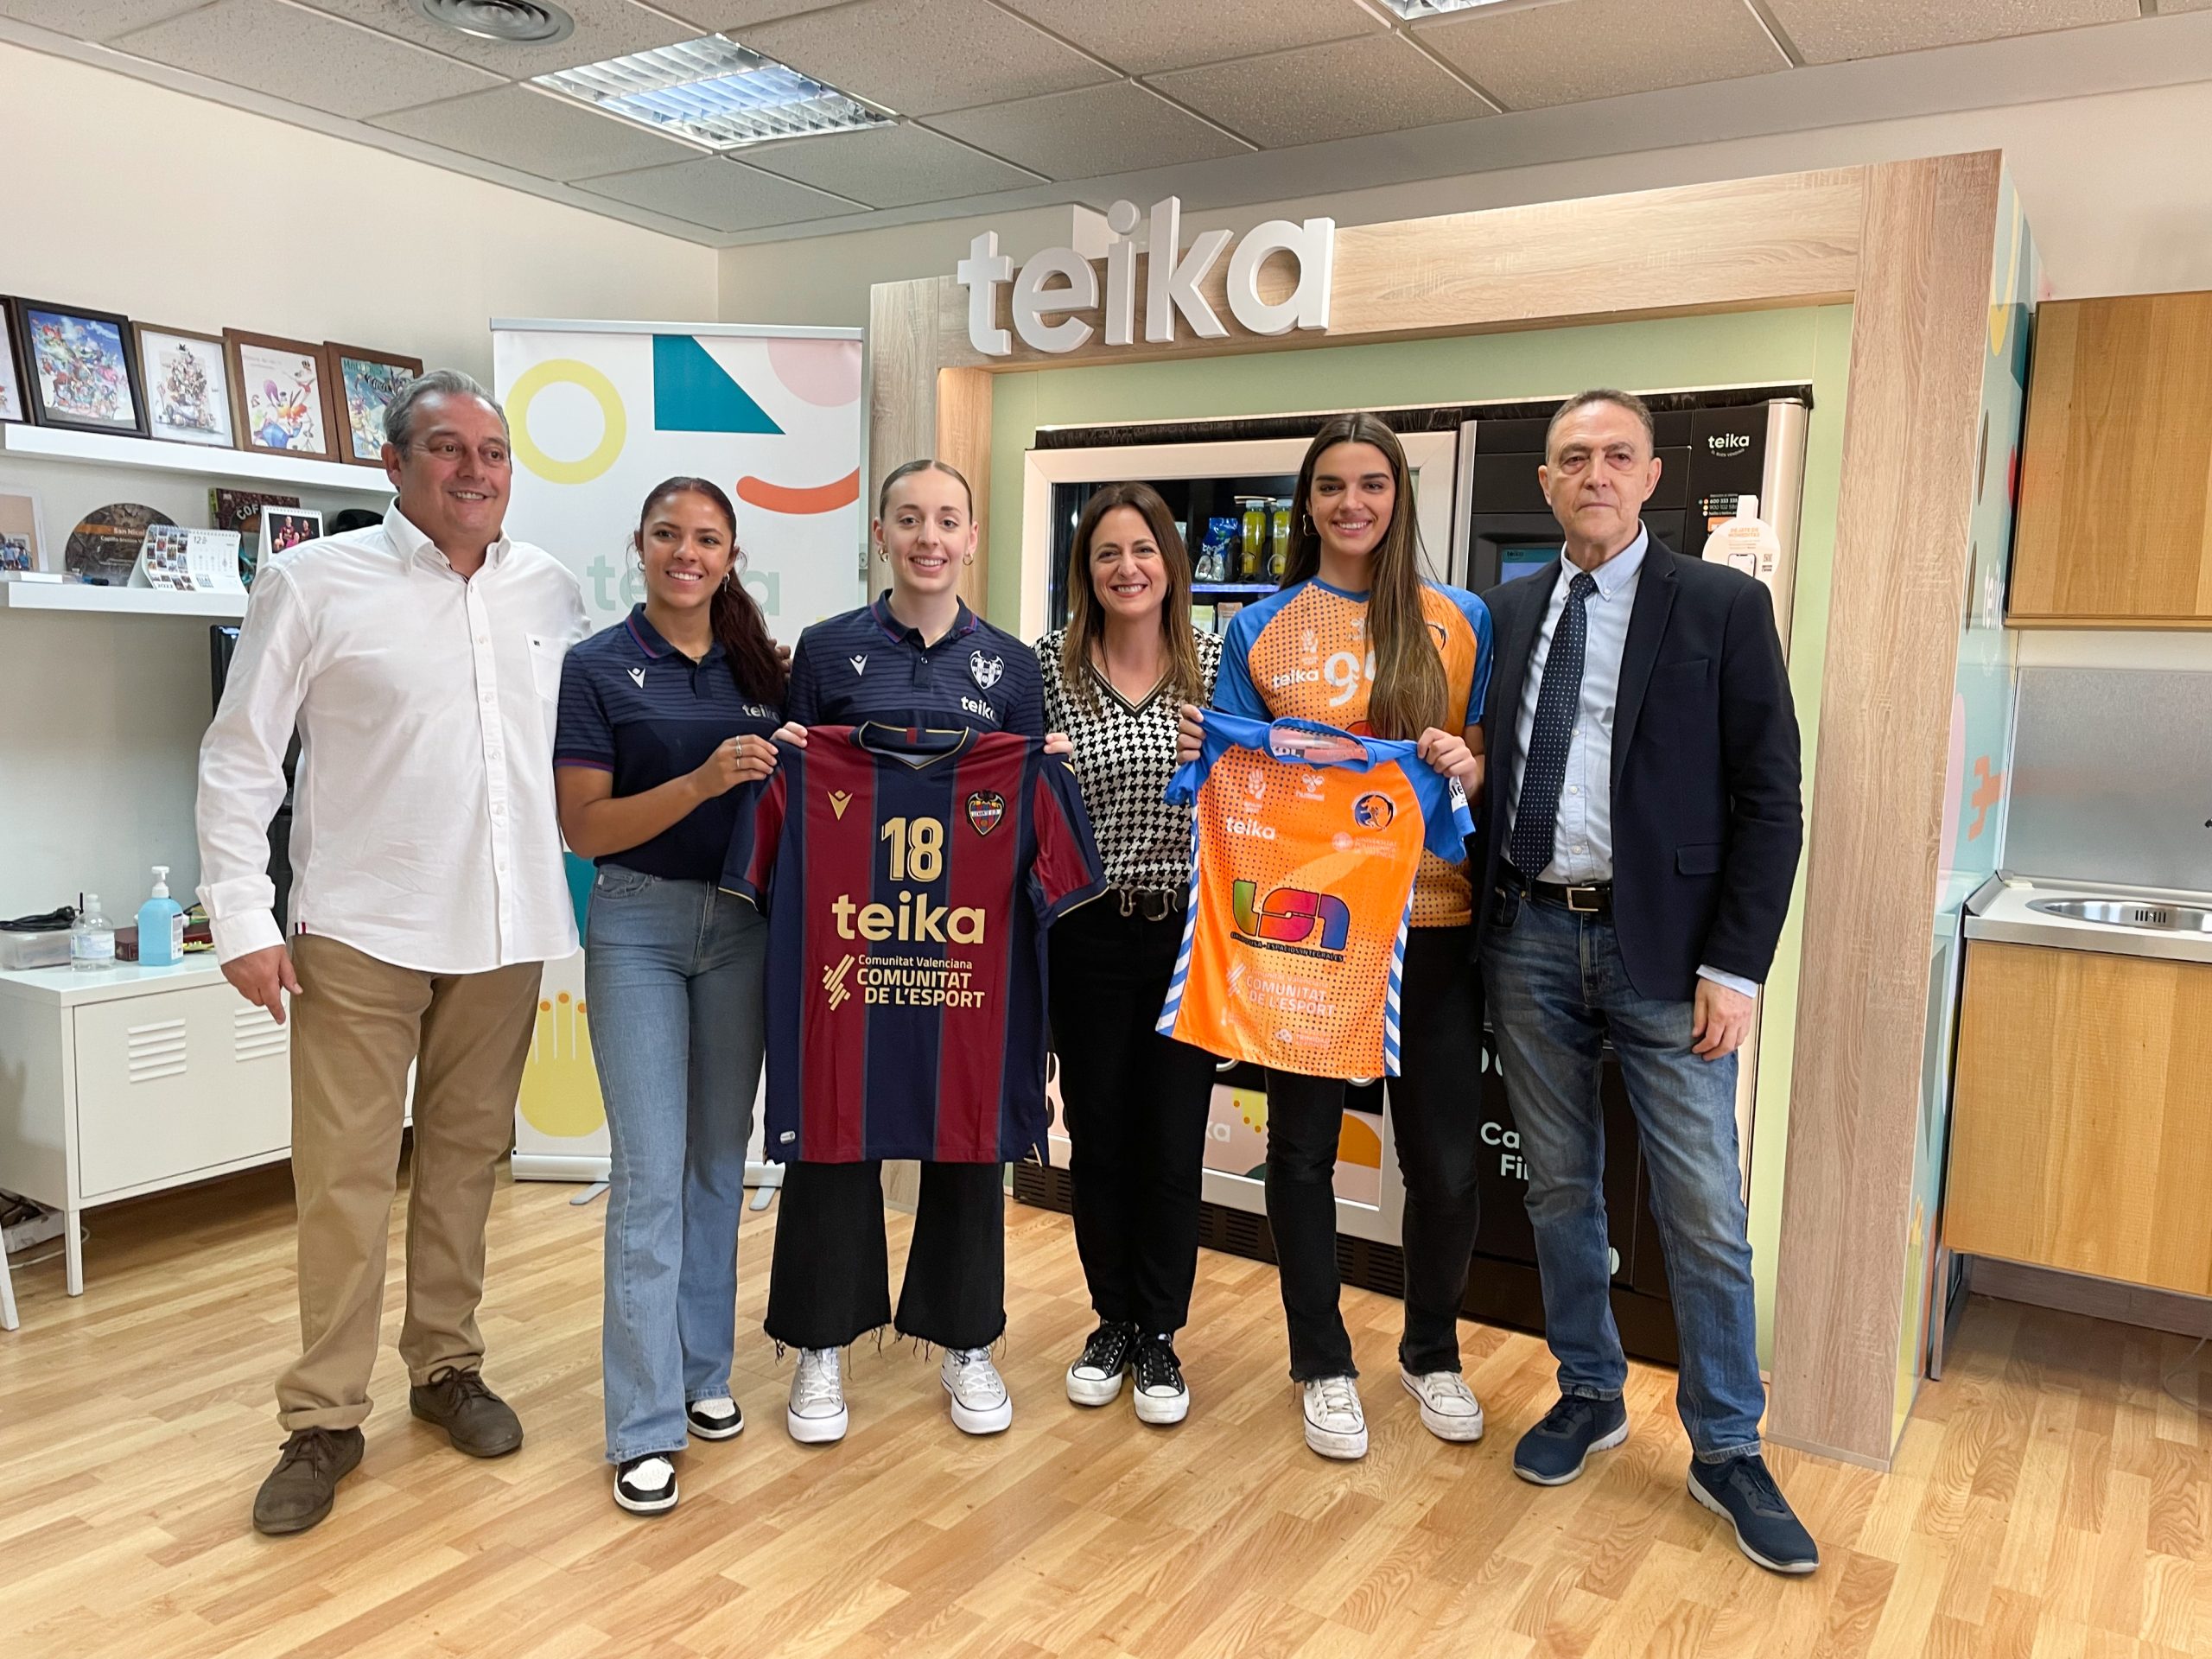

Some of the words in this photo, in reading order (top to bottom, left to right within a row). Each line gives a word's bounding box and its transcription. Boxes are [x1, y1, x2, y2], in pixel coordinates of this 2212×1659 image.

[957, 195, 1336, 356] teika
[1707, 433, 1750, 448] teika
[1272, 668, 1319, 690] teika
[1225, 815, 1277, 841] teika
[880, 817, 945, 882] 18
[831, 890, 986, 944] teika
[858, 954, 914, 967] Comunitat
[916, 957, 973, 969] Valenciana
[856, 968, 972, 988] COMUNITAT
[1246, 976, 1328, 1002] COMUNITAT
[865, 987, 890, 1004] DE
[895, 988, 985, 1008] L'ESPORT
[1249, 989, 1265, 1005] DE
